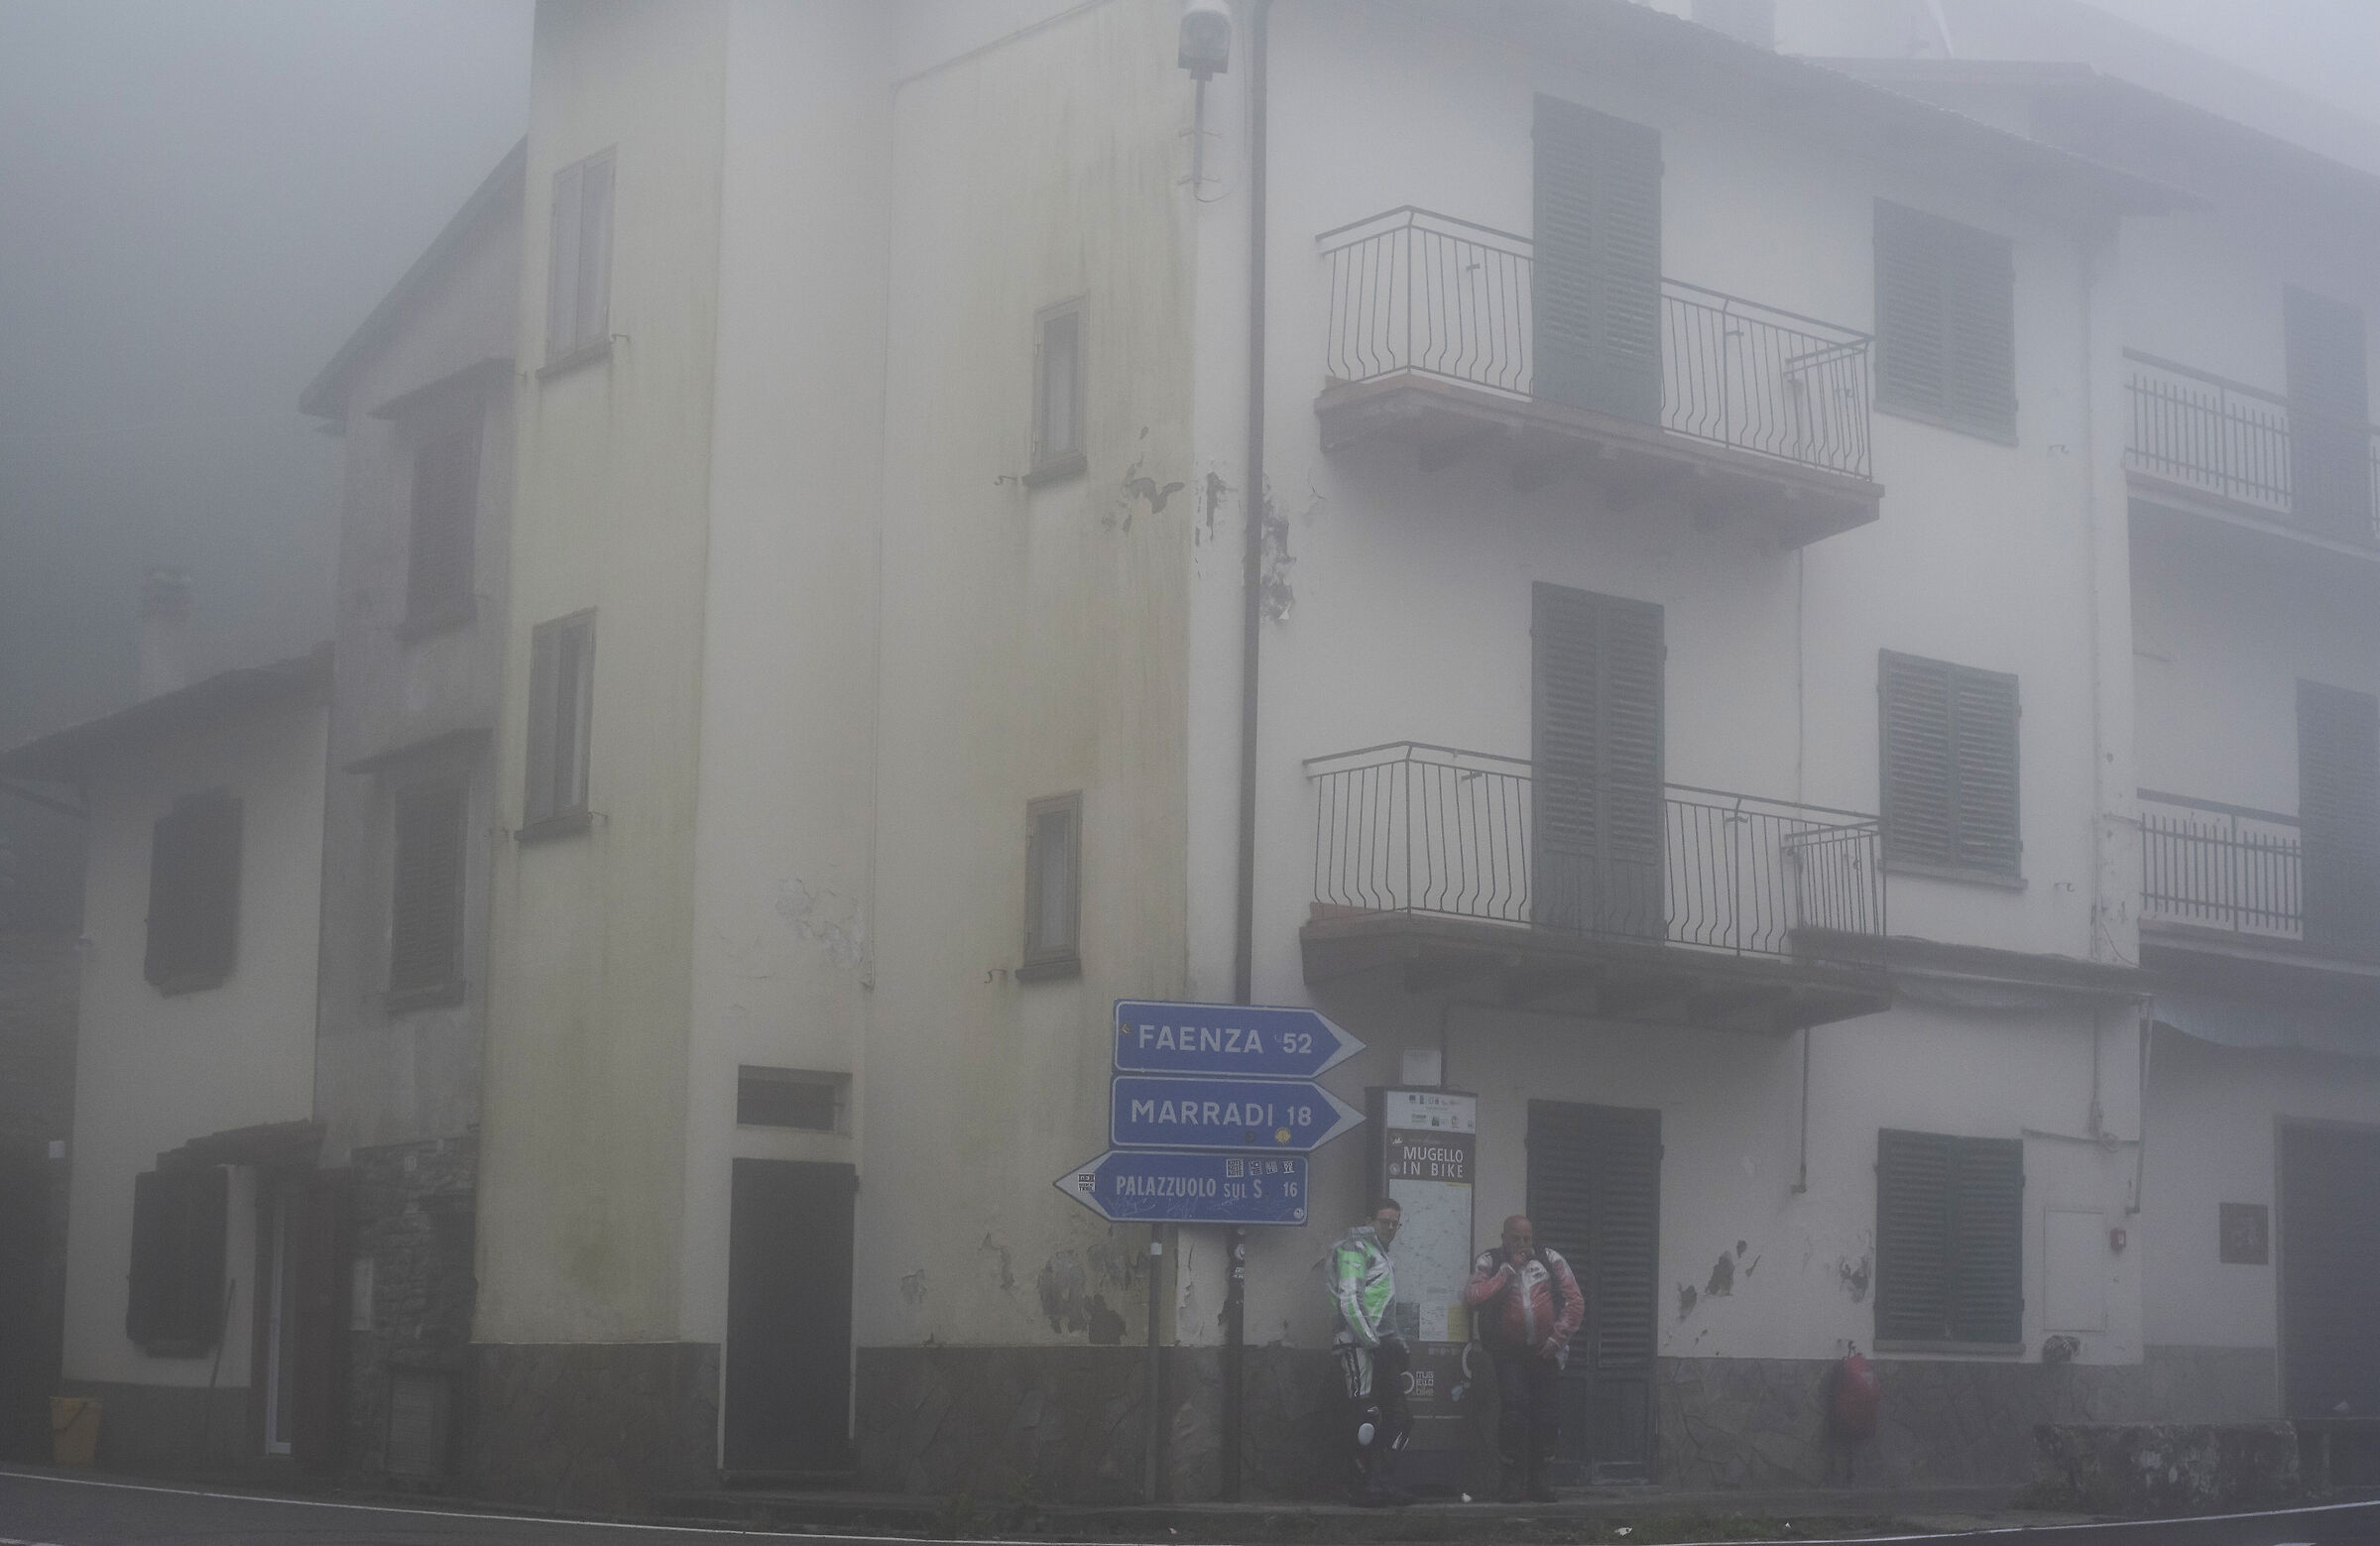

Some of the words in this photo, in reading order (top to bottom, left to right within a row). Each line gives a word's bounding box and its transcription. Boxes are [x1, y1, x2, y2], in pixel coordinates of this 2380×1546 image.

[1138, 1024, 1264, 1055] FAENZA
[1282, 1032, 1313, 1054] 52
[1130, 1099, 1274, 1128] MARRADI
[1286, 1106, 1313, 1127] 18
[1403, 1145, 1465, 1163] MUGELLO
[1403, 1161, 1421, 1175] IN
[1431, 1162, 1465, 1179] BIKE
[1116, 1175, 1218, 1198] PALAZZUOLO
[1223, 1182, 1248, 1200] SUL
[1282, 1181, 1299, 1198] 16
